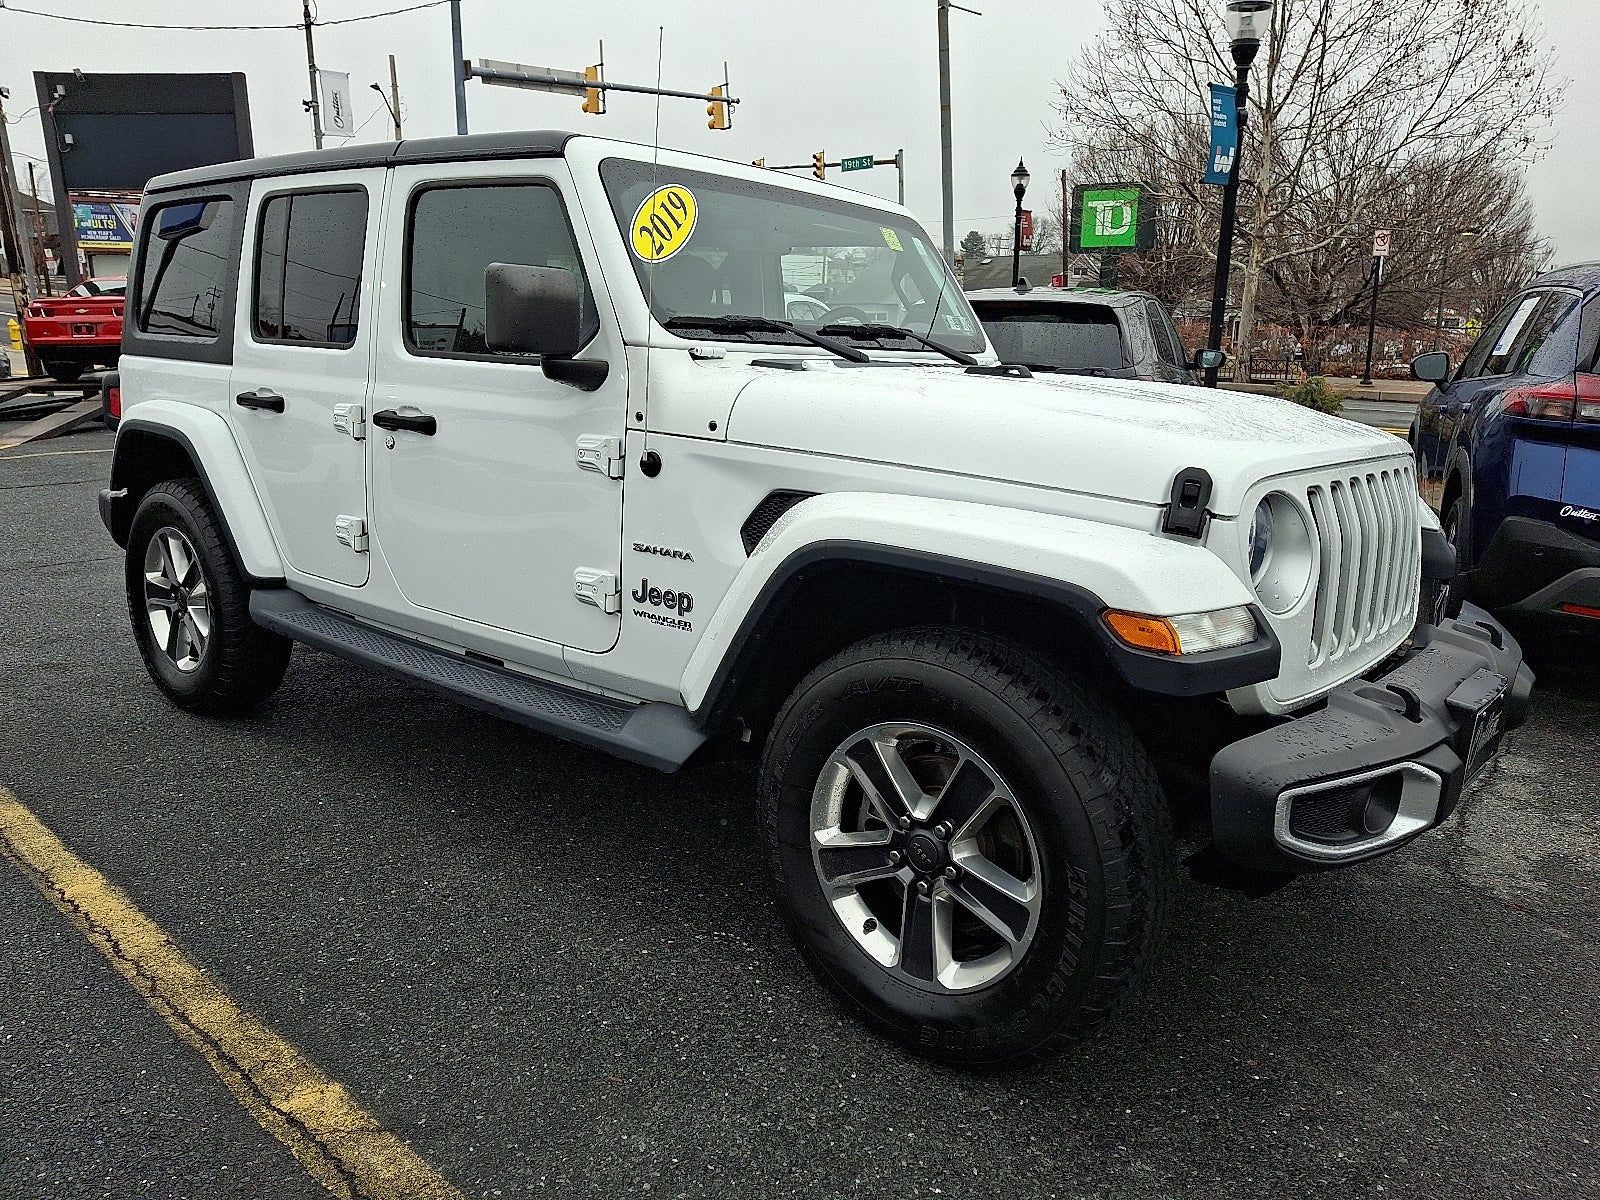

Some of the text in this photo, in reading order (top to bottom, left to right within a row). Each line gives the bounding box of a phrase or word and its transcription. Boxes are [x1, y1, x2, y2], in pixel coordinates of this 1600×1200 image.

[844, 157, 871, 169] 19th St
[92, 219, 117, 229] ULTS!
[639, 191, 687, 256] 2019
[1088, 200, 1132, 236] TD
[632, 543, 695, 563] SAHARA
[631, 577, 694, 617] Jeep
[632, 608, 693, 628] WRANGLER
